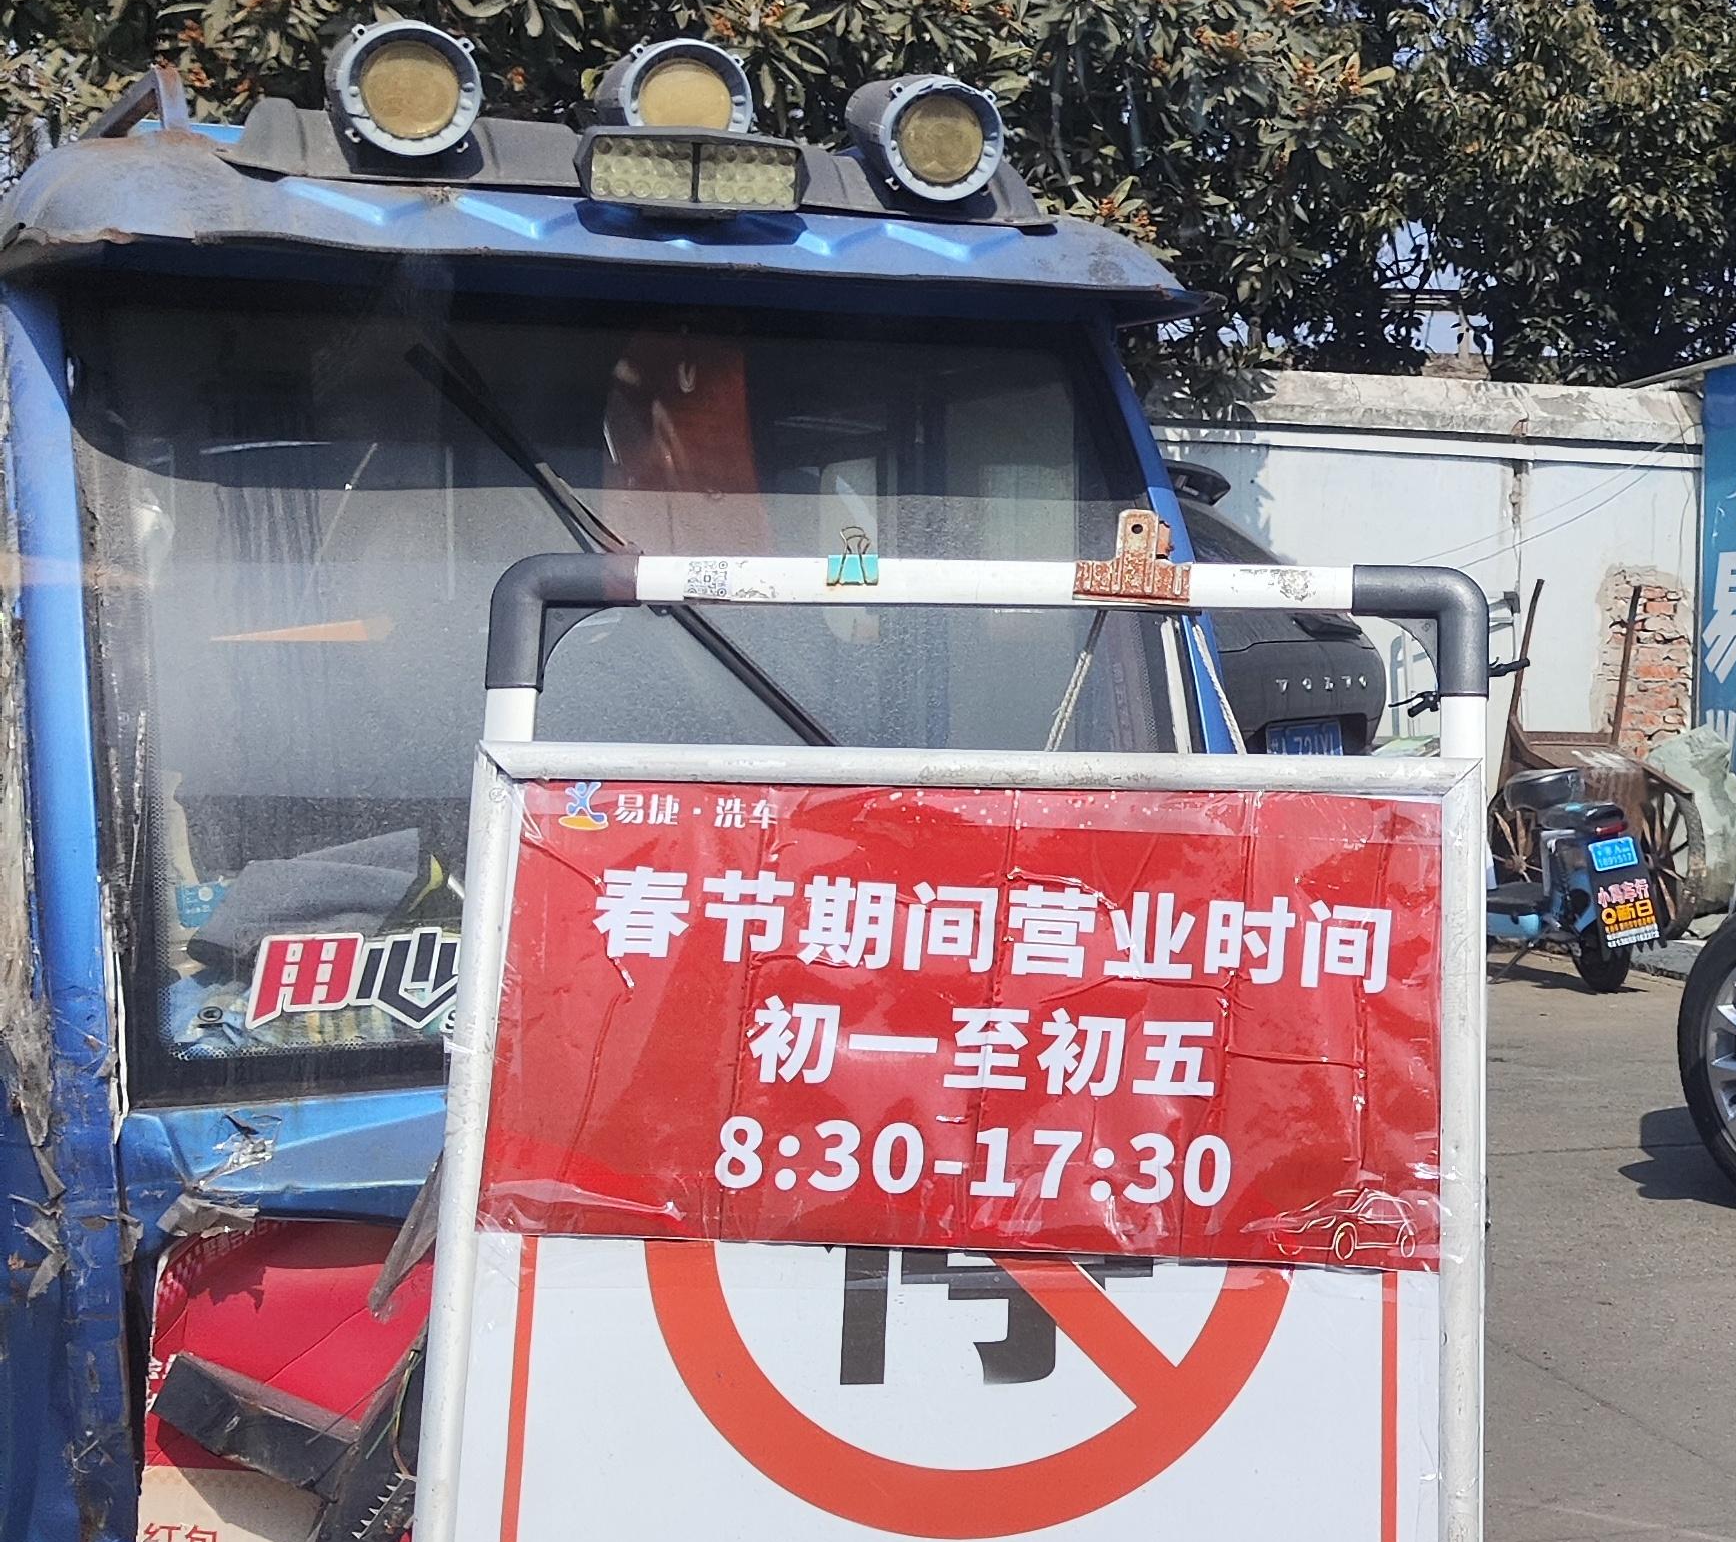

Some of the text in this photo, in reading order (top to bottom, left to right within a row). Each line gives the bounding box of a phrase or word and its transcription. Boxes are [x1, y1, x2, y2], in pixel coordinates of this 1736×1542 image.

[595, 865, 1393, 994] 春节期间营业时间
[748, 994, 1216, 1099] 初一至初五
[716, 1114, 1233, 1208] 8:30-17:30
